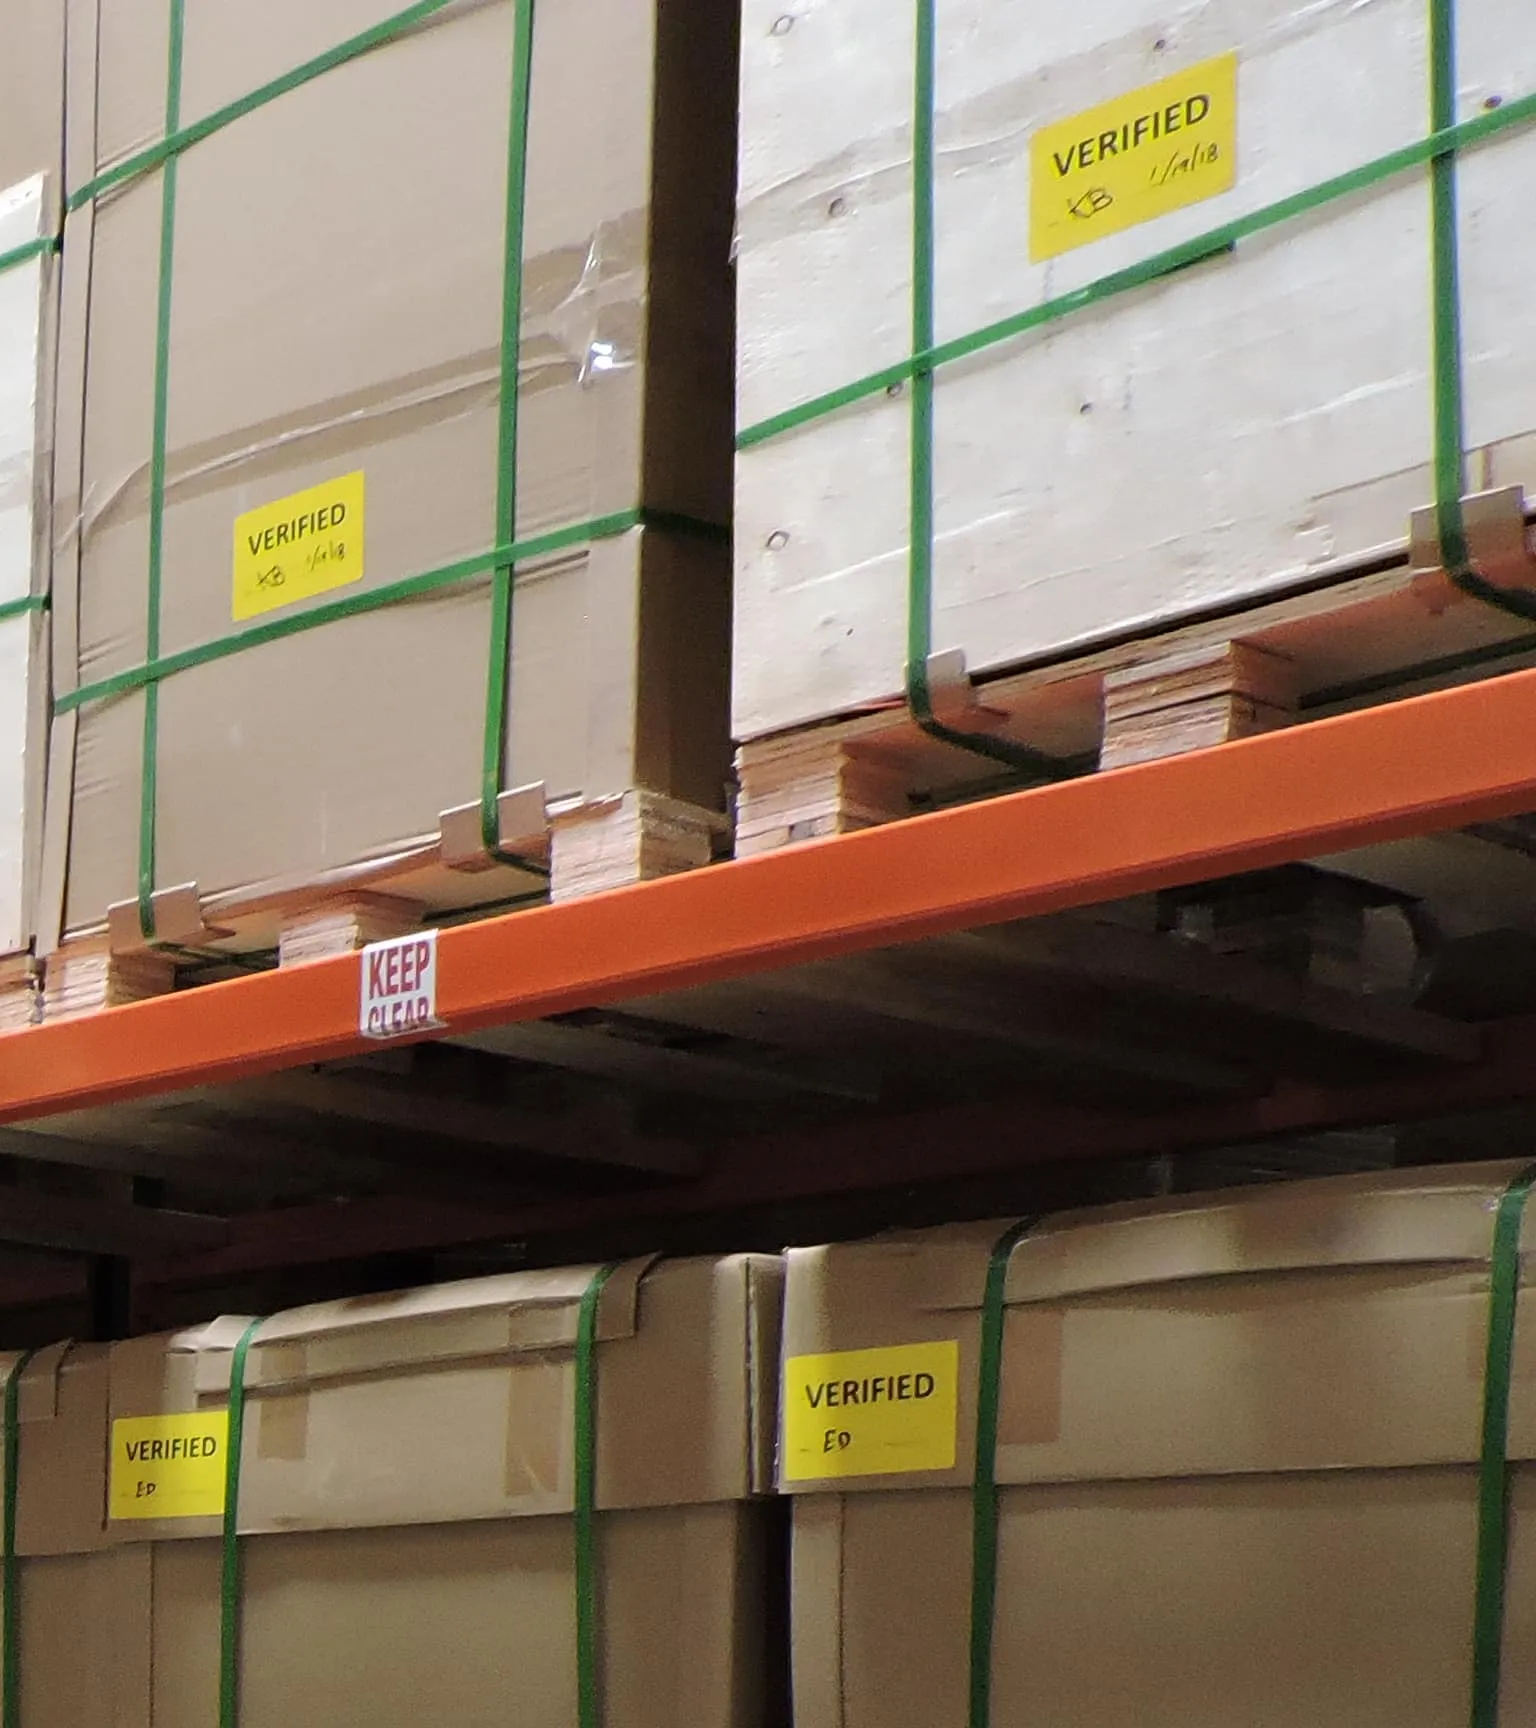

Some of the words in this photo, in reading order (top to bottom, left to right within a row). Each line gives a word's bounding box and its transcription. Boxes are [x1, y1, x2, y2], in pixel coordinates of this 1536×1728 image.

[1052, 94, 1210, 177] VERIFIED
[248, 502, 346, 556] VERIFIED
[369, 940, 431, 1001] KEEP
[805, 1372, 935, 1409] VERIFIED
[126, 1436, 217, 1462] VERIFIED
